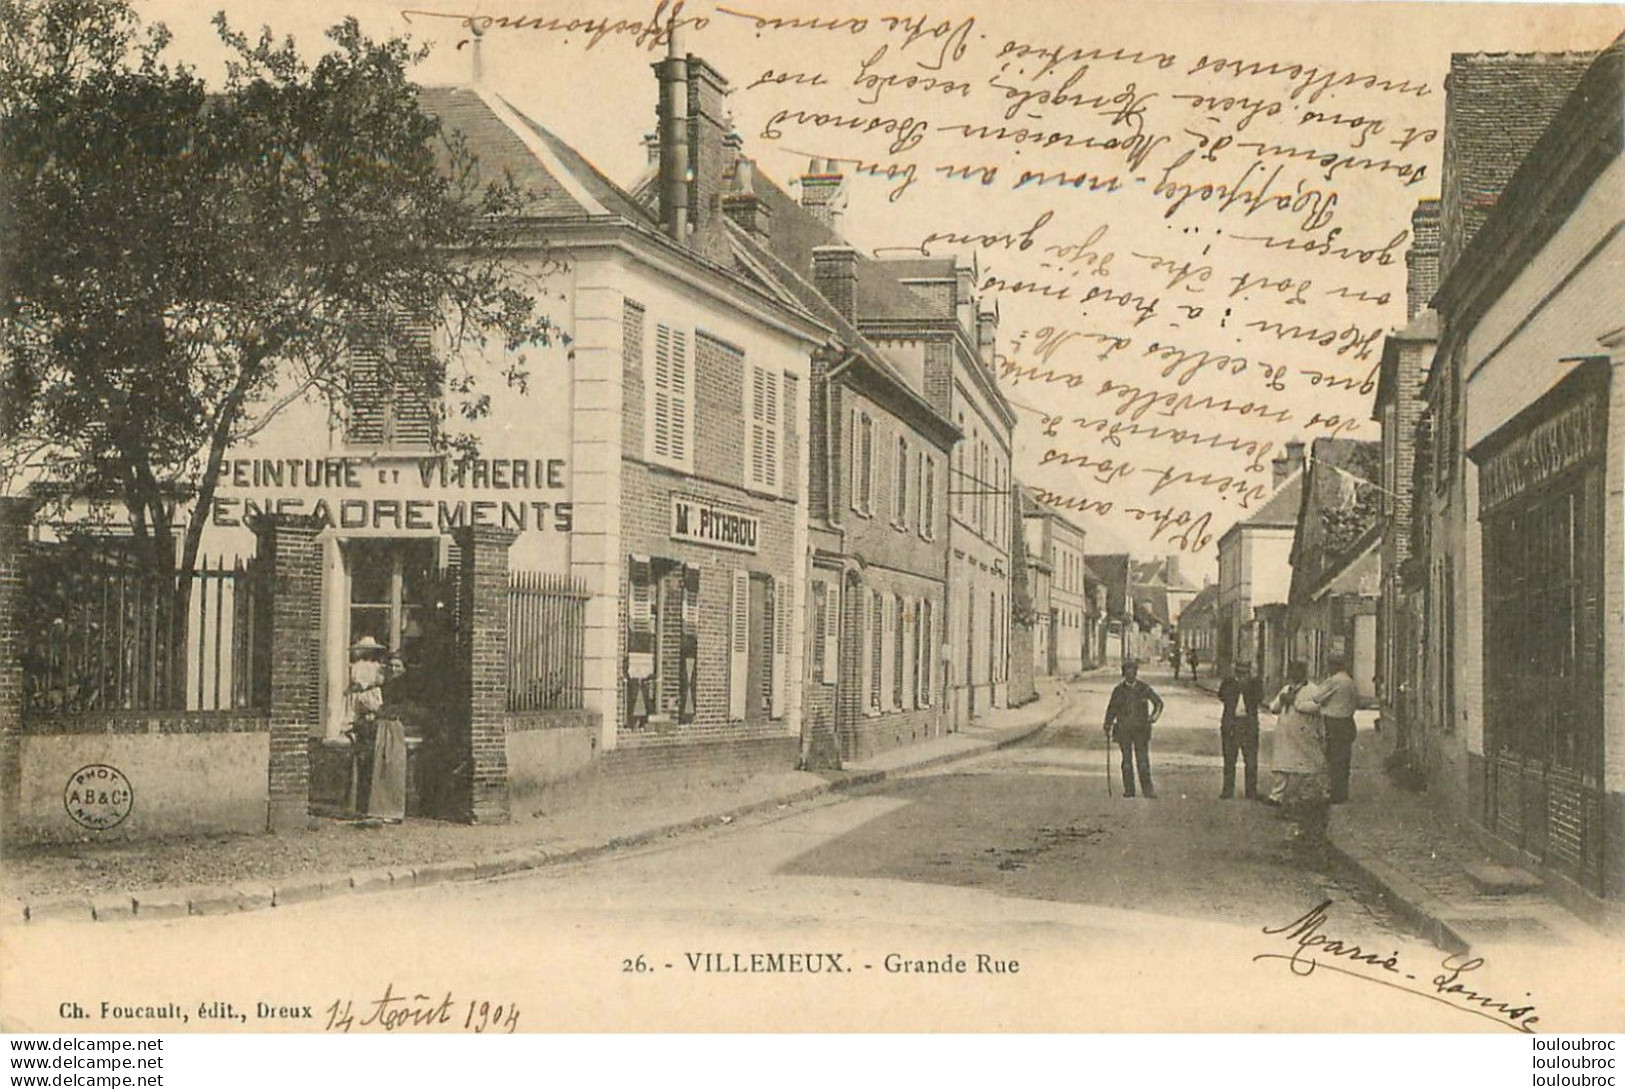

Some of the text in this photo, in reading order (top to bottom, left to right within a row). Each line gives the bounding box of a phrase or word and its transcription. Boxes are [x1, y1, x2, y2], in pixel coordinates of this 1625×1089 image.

[737, 12, 868, 38] amie
[881, 14, 974, 70] Votre
[746, 70, 825, 89] nos
[852, 44, 970, 104] recevez
[1188, 55, 1431, 103] meilleures
[1172, 95, 1281, 131] chère
[937, 116, 1170, 173] Monsieur
[1184, 129, 1233, 162] de
[1390, 128, 1438, 151] et
[1238, 144, 1426, 186] souvenir
[909, 210, 1054, 258] grand
[1230, 227, 1408, 268] garçon
[1131, 251, 1212, 292] être
[1230, 273, 1311, 305] doit
[1079, 287, 1157, 317] trois
[1327, 286, 1391, 307] on
[1085, 332, 1131, 359] de
[1235, 319, 1384, 361] Henri
[1149, 343, 1247, 384] celles
[1258, 361, 1285, 391] de
[1300, 362, 1380, 395] que
[1101, 380, 1289, 423] nouvelles
[1072, 415, 1272, 473] demander
[1304, 412, 1359, 443] vos
[216, 458, 565, 489] PEINTURE ET VITRERIE
[1038, 448, 1265, 509] vient vous
[1125, 507, 1212, 554] Votre
[464, 1000, 521, 1033] 1904
